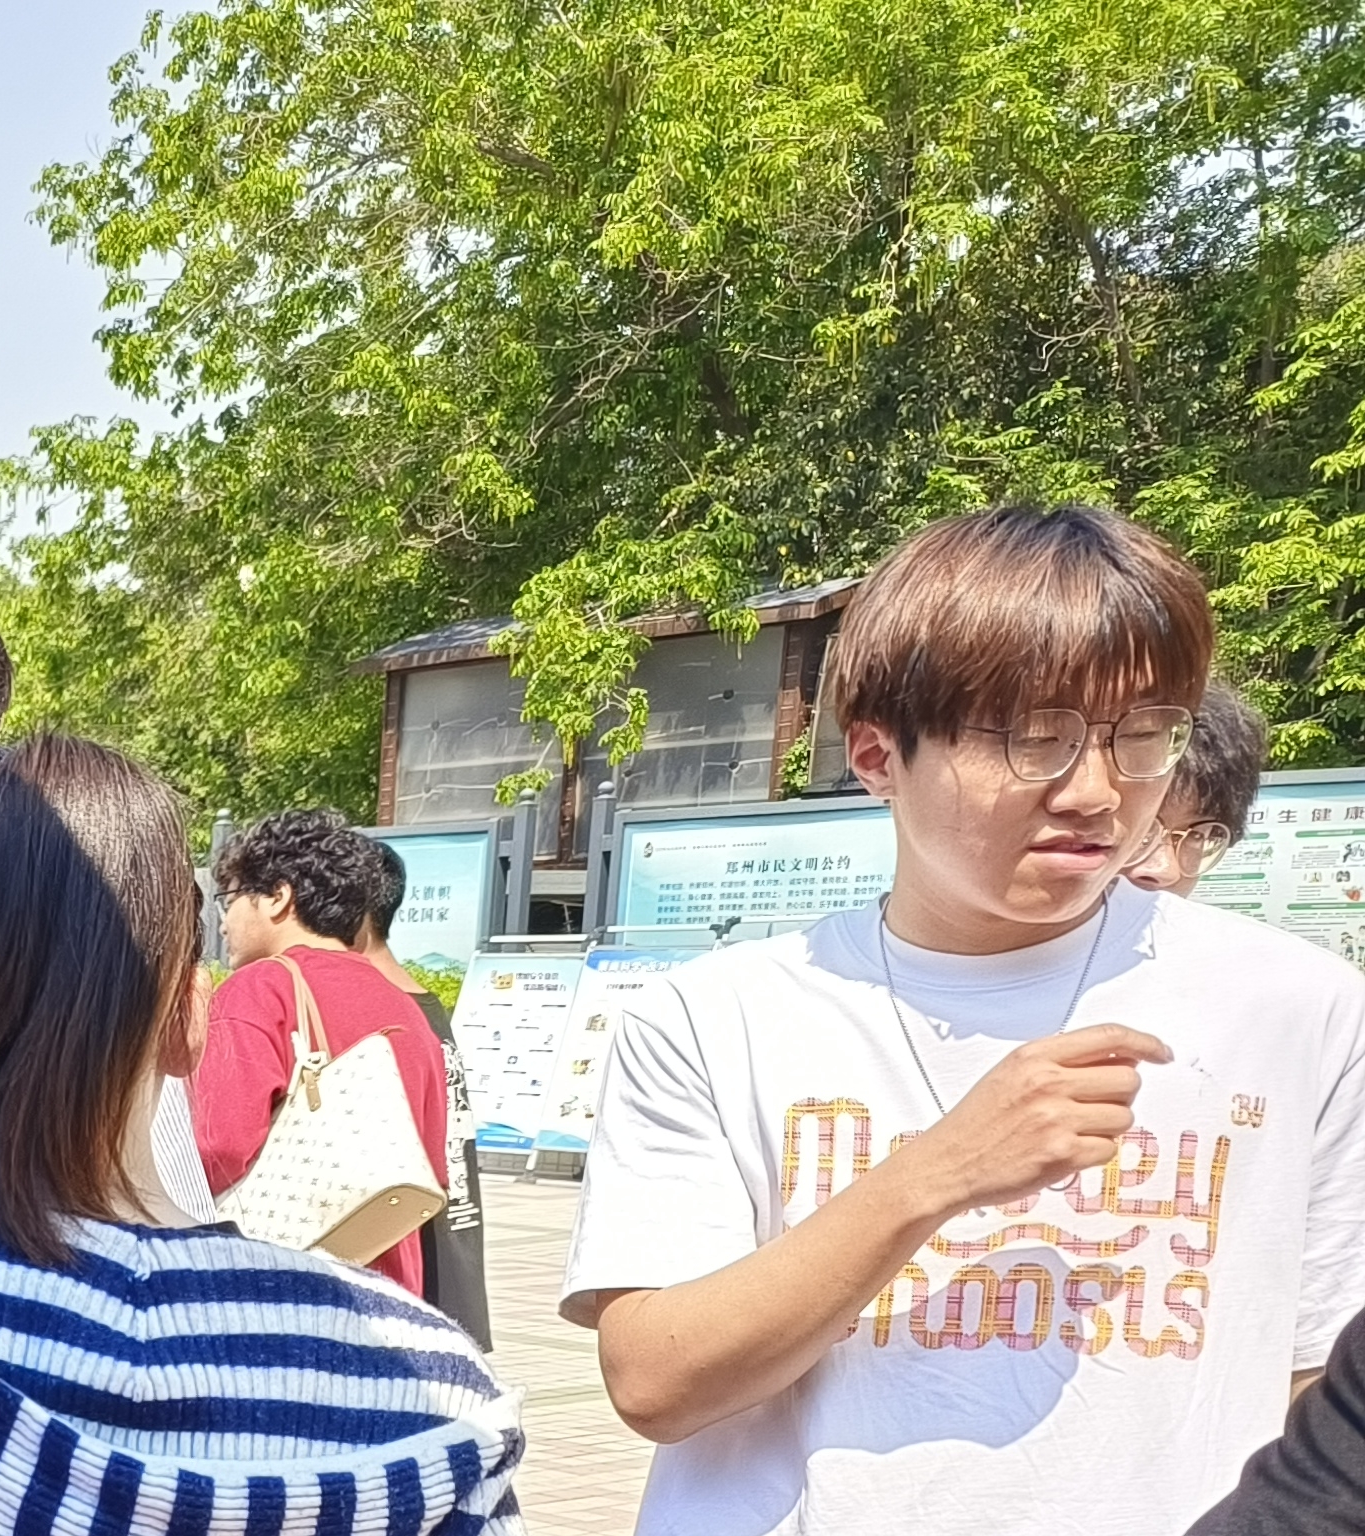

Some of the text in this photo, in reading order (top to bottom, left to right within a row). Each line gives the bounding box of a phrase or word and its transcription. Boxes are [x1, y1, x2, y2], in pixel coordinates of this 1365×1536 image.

[725, 855, 852, 875] 郑州市民文明公约
